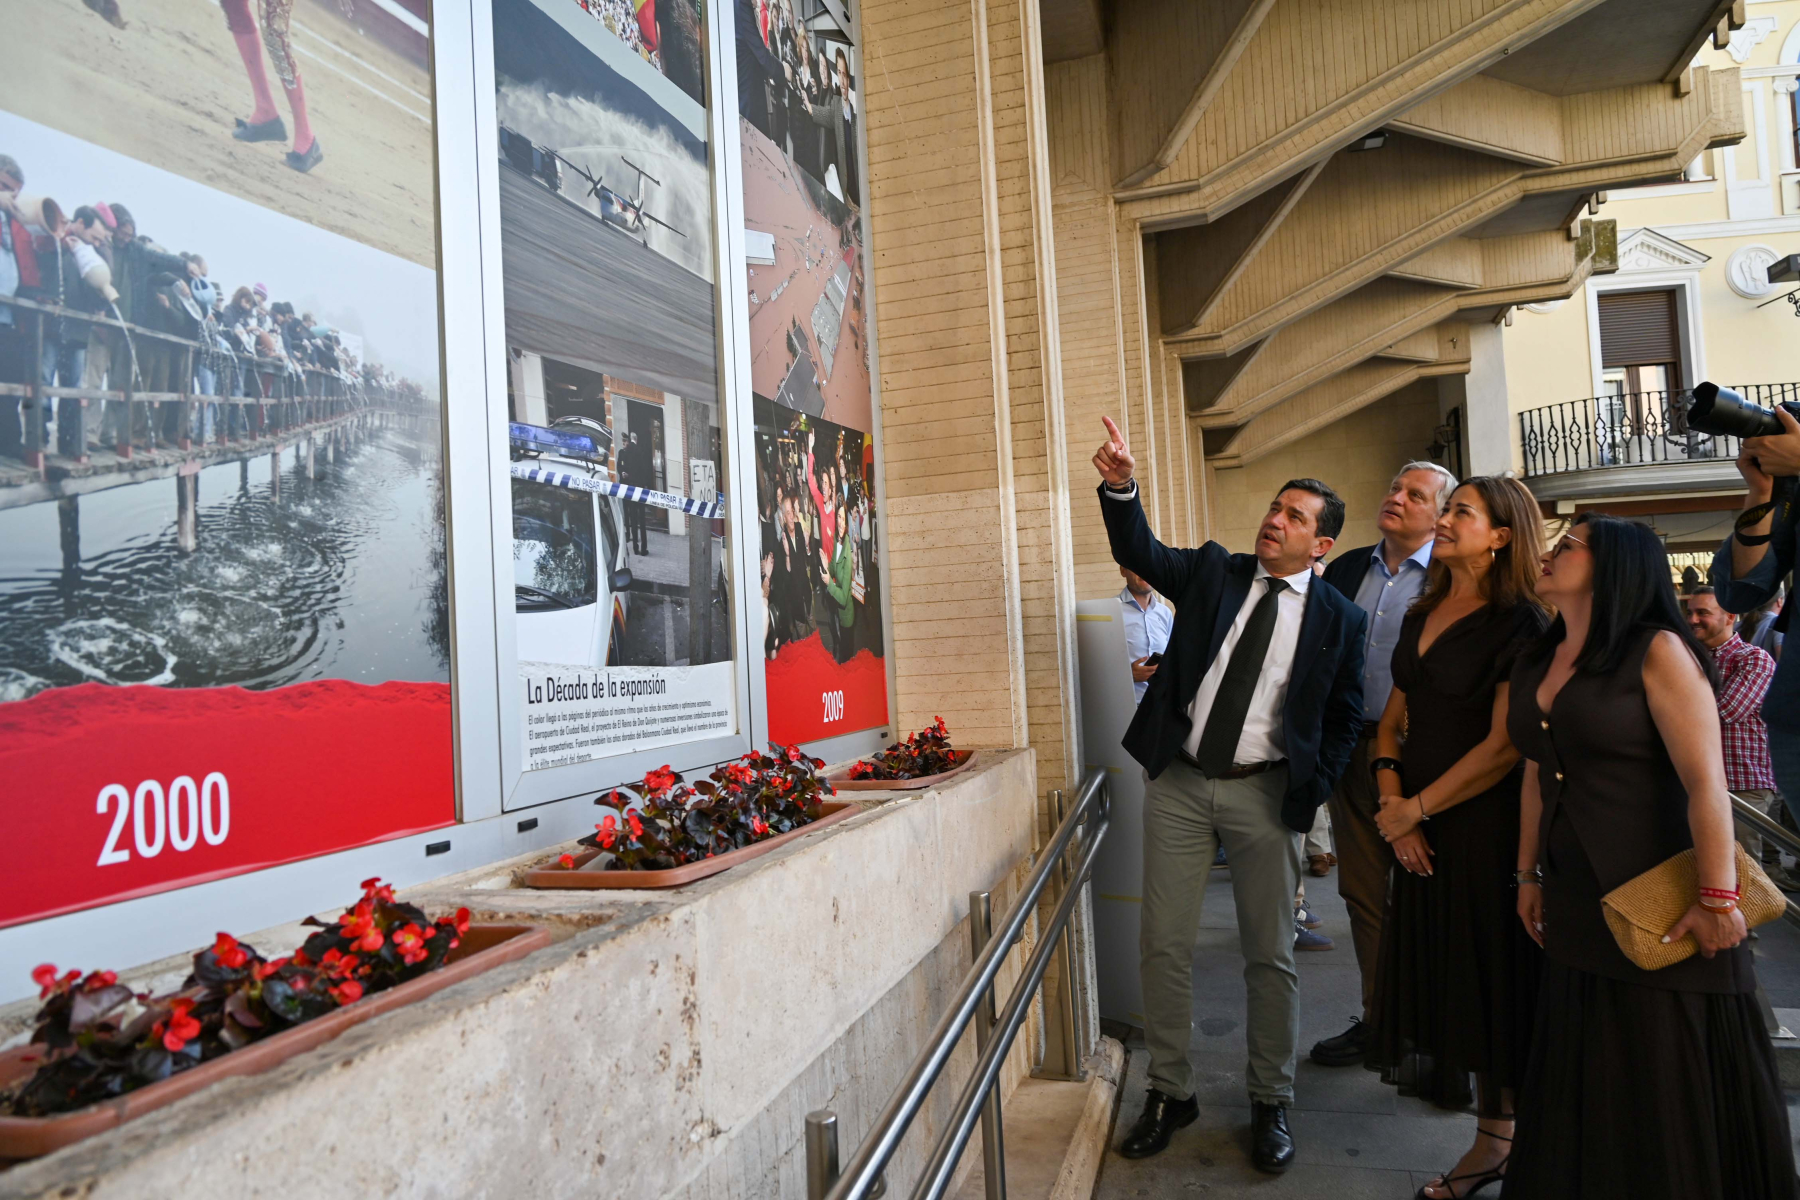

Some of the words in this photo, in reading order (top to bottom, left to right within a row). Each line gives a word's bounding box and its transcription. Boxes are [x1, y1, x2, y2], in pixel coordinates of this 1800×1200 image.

[572, 477, 580, 486] NO
[582, 478, 600, 490] PASAR
[693, 465, 714, 482] ETA
[660, 494, 676, 504] PASAR
[528, 678, 542, 704] La
[546, 674, 588, 702] Década
[592, 673, 604, 699] de
[608, 672, 617, 698] la
[620, 672, 666, 702] expansión
[528, 714, 534, 725] El
[534, 714, 545, 724] color
[546, 712, 556, 724] llegó
[568, 710, 584, 722] páginas
[592, 708, 609, 720] periódico
[610, 706, 614, 716] al
[614, 706, 626, 716] mismo
[626, 706, 636, 714] ritmo
[657, 702, 662, 712] de
[662, 702, 678, 710] crecimiento
[682, 700, 696, 710] optimismo
[822, 690, 844, 723] 2009
[528, 730, 534, 740] El
[534, 728, 558, 740] aeropuerto
[560, 726, 564, 736] de
[566, 724, 580, 735] Ciudad
[580, 722, 591, 734] Real,
[592, 722, 596, 732] el
[596, 722, 612, 734] proyecto
[612, 720, 617, 729] de
[618, 720, 621, 728] El
[622, 719, 632, 728] Reino
[632, 718, 636, 726] de
[645, 716, 657, 726] Quijote
[660, 716, 676, 724] numerosas
[676, 713, 692, 722] inversiones
[530, 744, 548, 758] grandes
[575, 738, 590, 748] Fueron
[590, 735, 606, 746] también
[612, 734, 622, 742] años
[622, 732, 636, 742] dorados
[642, 729, 660, 738] Balonmano
[661, 726, 672, 736] Ciudad
[697, 722, 708, 730] nombre
[96, 771, 230, 867] 2000
